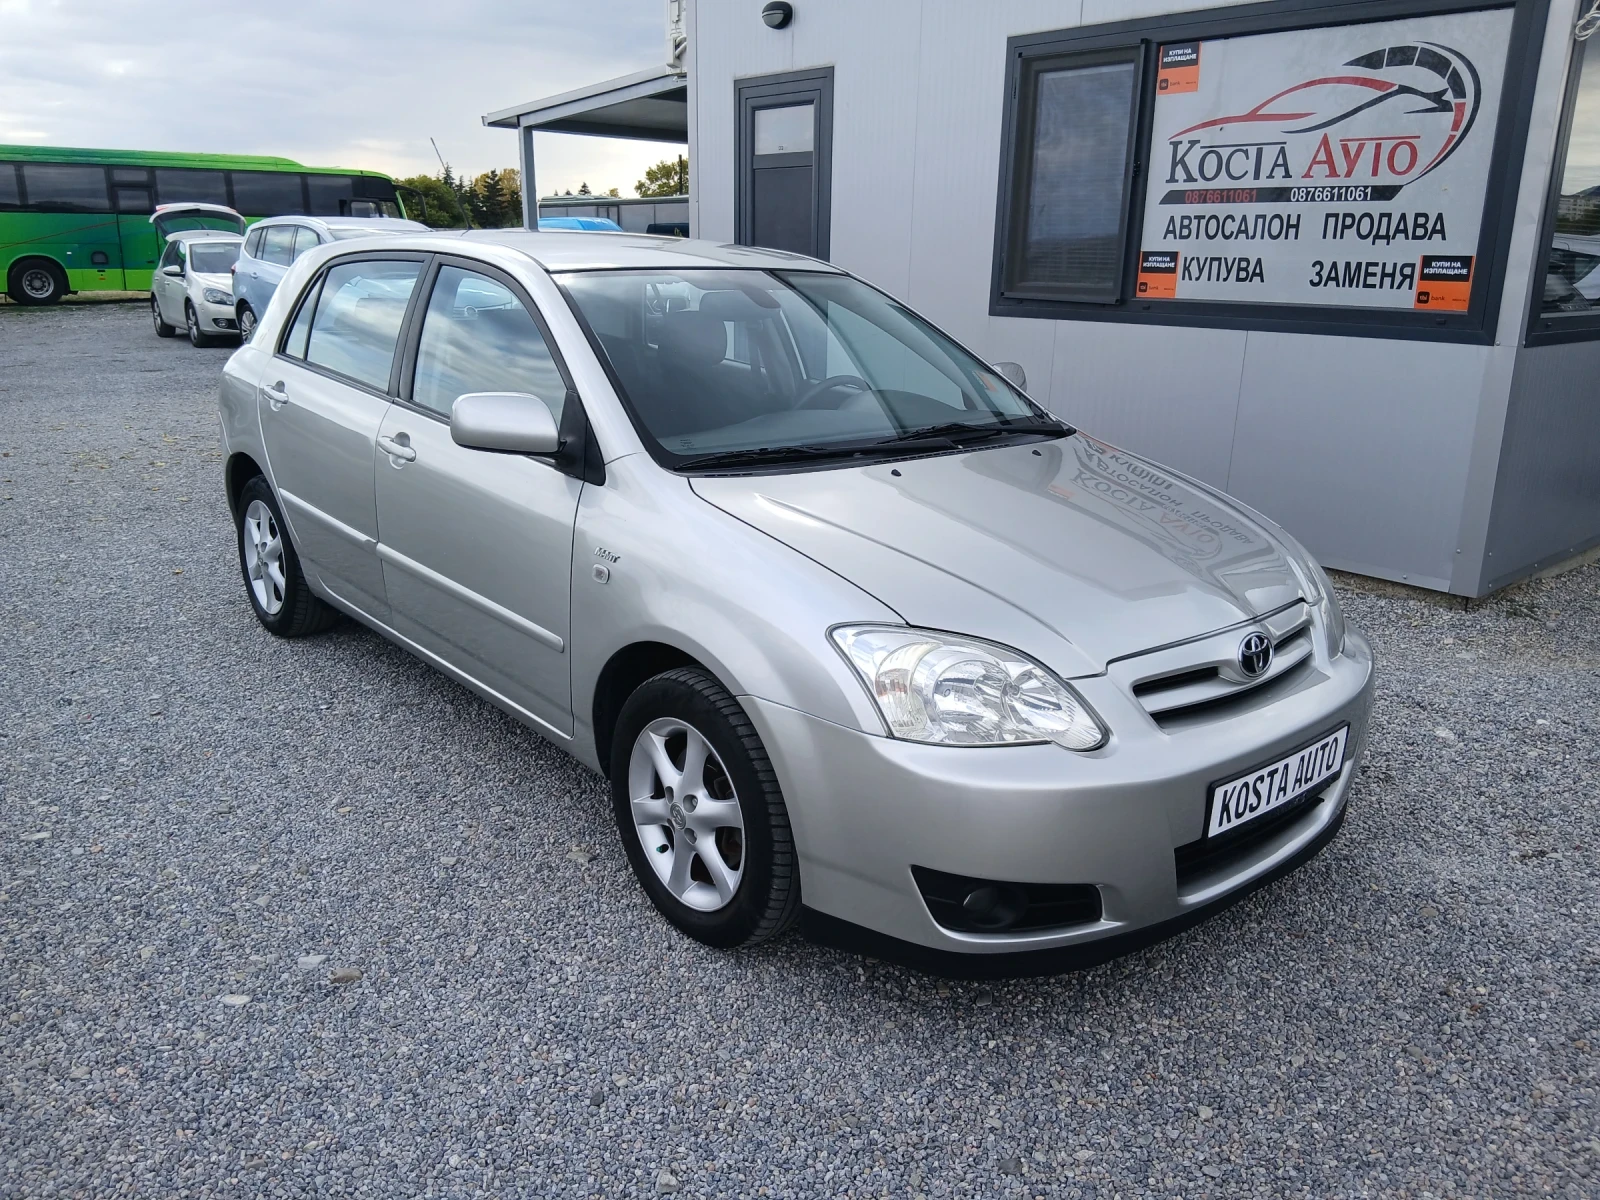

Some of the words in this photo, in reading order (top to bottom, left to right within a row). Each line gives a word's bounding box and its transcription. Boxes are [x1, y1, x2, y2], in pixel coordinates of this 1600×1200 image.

[1185, 188, 1257, 204] 0876611061
[1290, 186, 1372, 202] 0876611061
[1163, 213, 1301, 241] АВТОСАЛОН
[1322, 212, 1447, 246] ПРОДАВА
[1181, 256, 1265, 283] КУПУВА
[1309, 260, 1416, 291] ЗАМЕНЯ
[1423, 267, 1468, 276] ИЗПЛАЩАНЕ
[1218, 762, 1290, 828] KOSTA
[1292, 736, 1339, 793] AUTO
